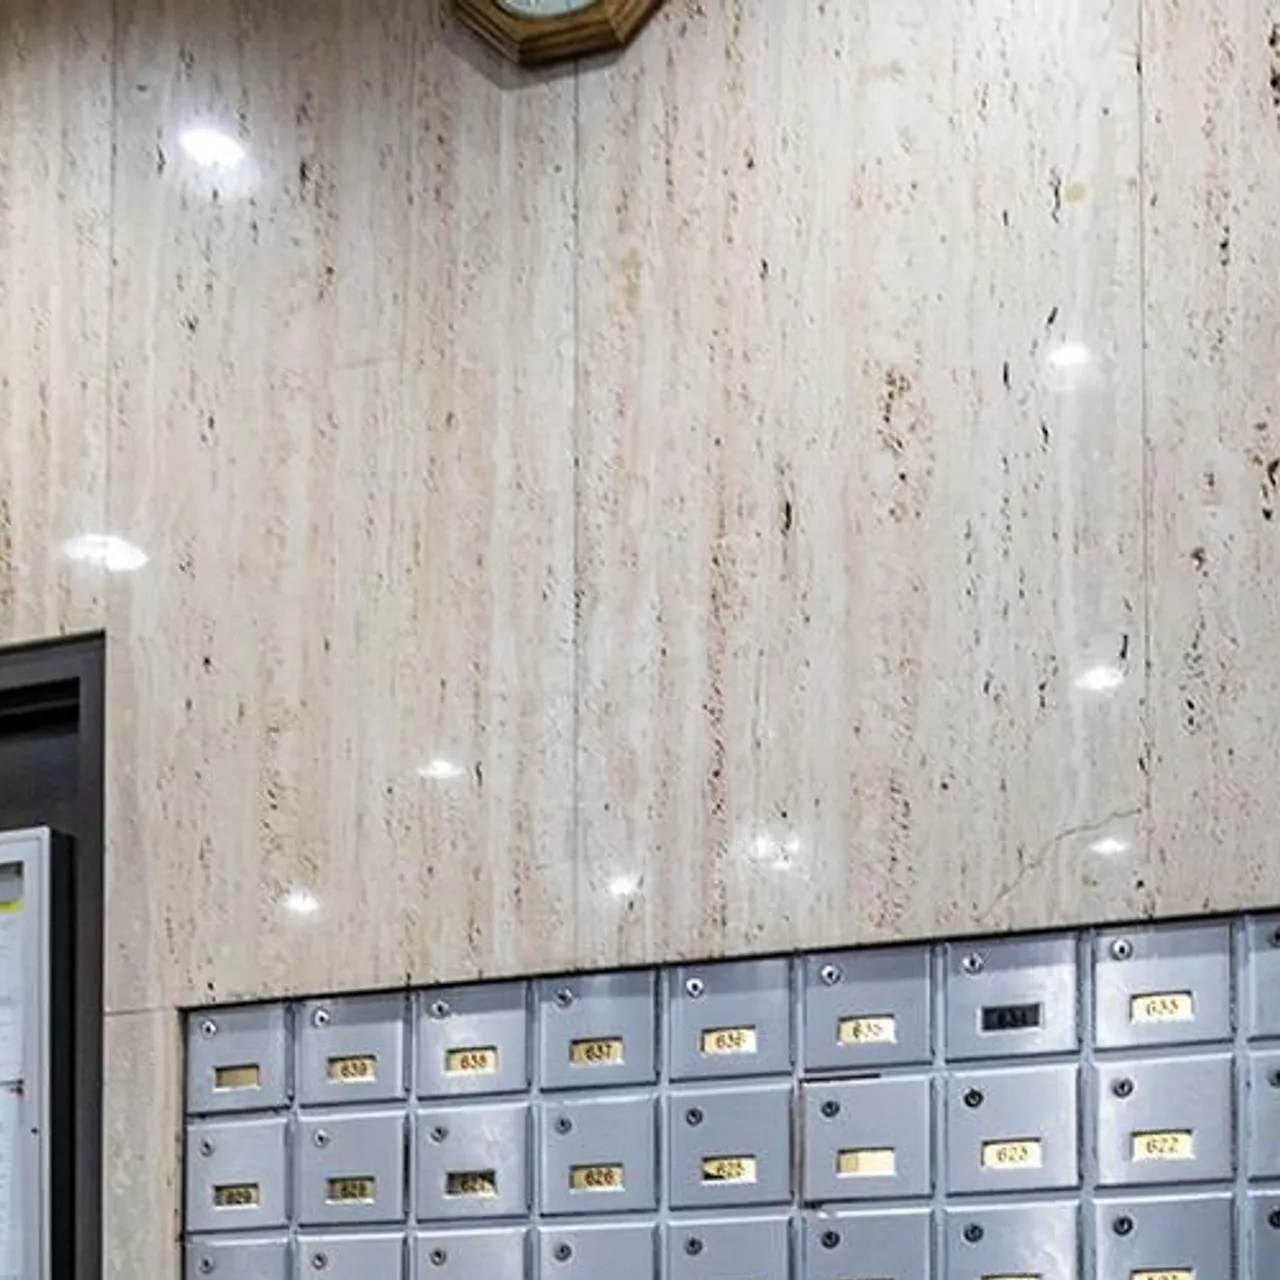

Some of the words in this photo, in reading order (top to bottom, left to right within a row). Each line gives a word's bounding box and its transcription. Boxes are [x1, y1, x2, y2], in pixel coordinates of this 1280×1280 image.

[585, 1045, 612, 1060] 637
[996, 1145, 1028, 1163] 623
[1146, 1137, 1179, 1154] 622
[585, 1168, 615, 1186] 626
